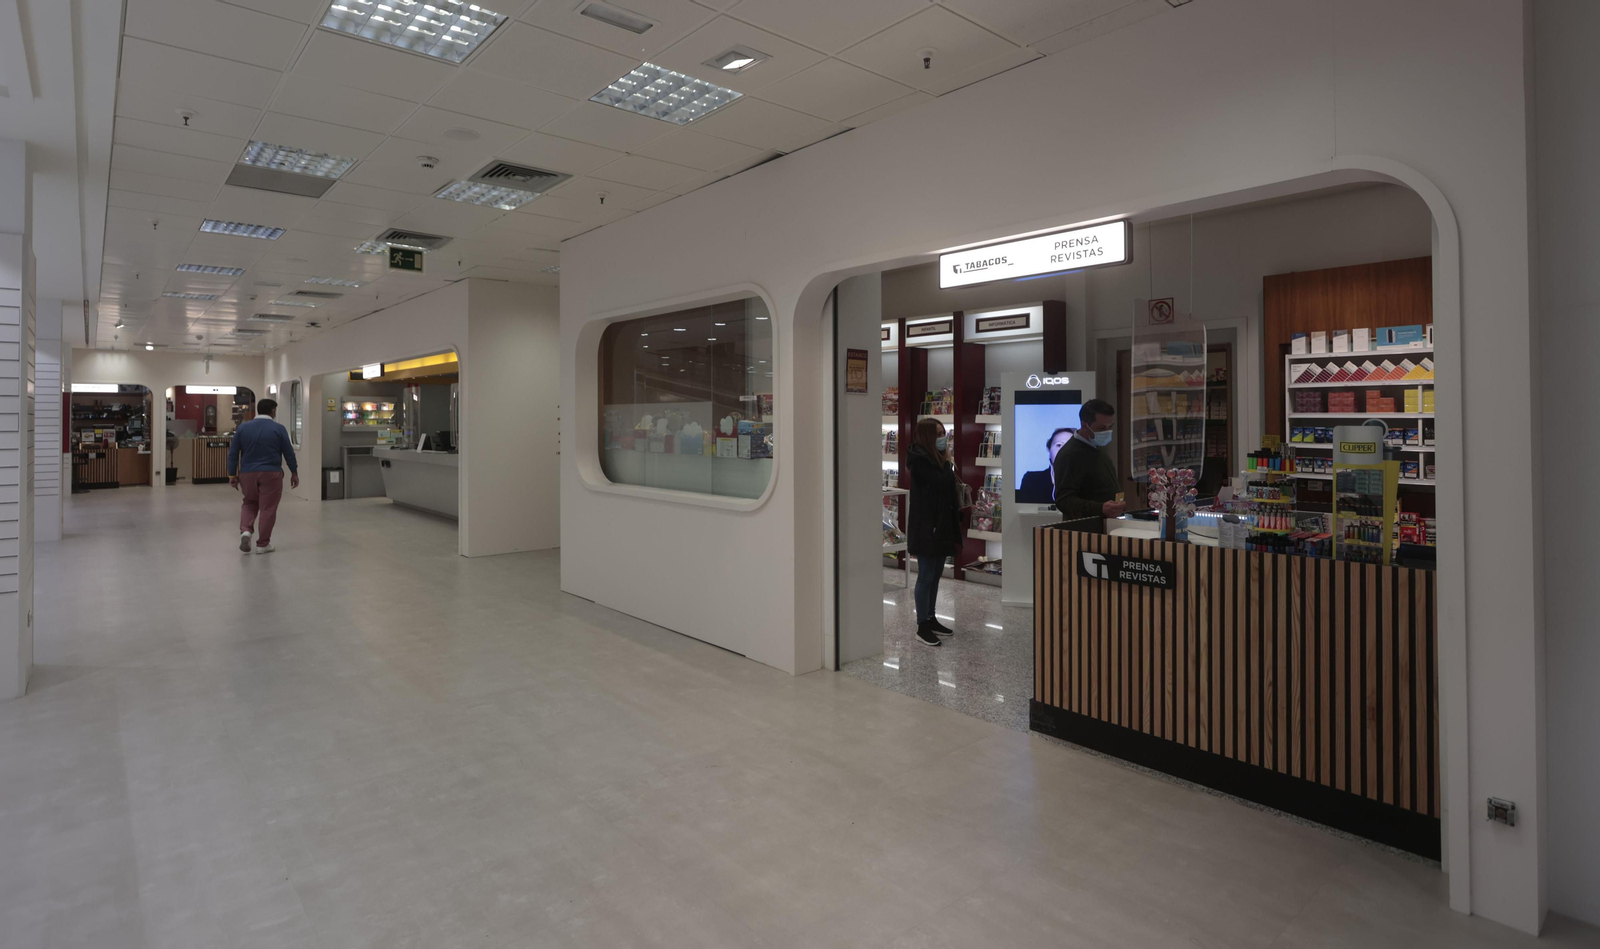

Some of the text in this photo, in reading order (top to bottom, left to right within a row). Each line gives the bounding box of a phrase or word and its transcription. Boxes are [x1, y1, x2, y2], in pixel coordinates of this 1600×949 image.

[1054, 235, 1099, 251] PRENSA
[1050, 246, 1104, 264] REVISTAS
[1042, 377, 1070, 386] IQOS
[1342, 444, 1373, 452] CLIPPER
[1122, 560, 1163, 574] PRENSA
[1119, 570, 1167, 586] REVISTAS
